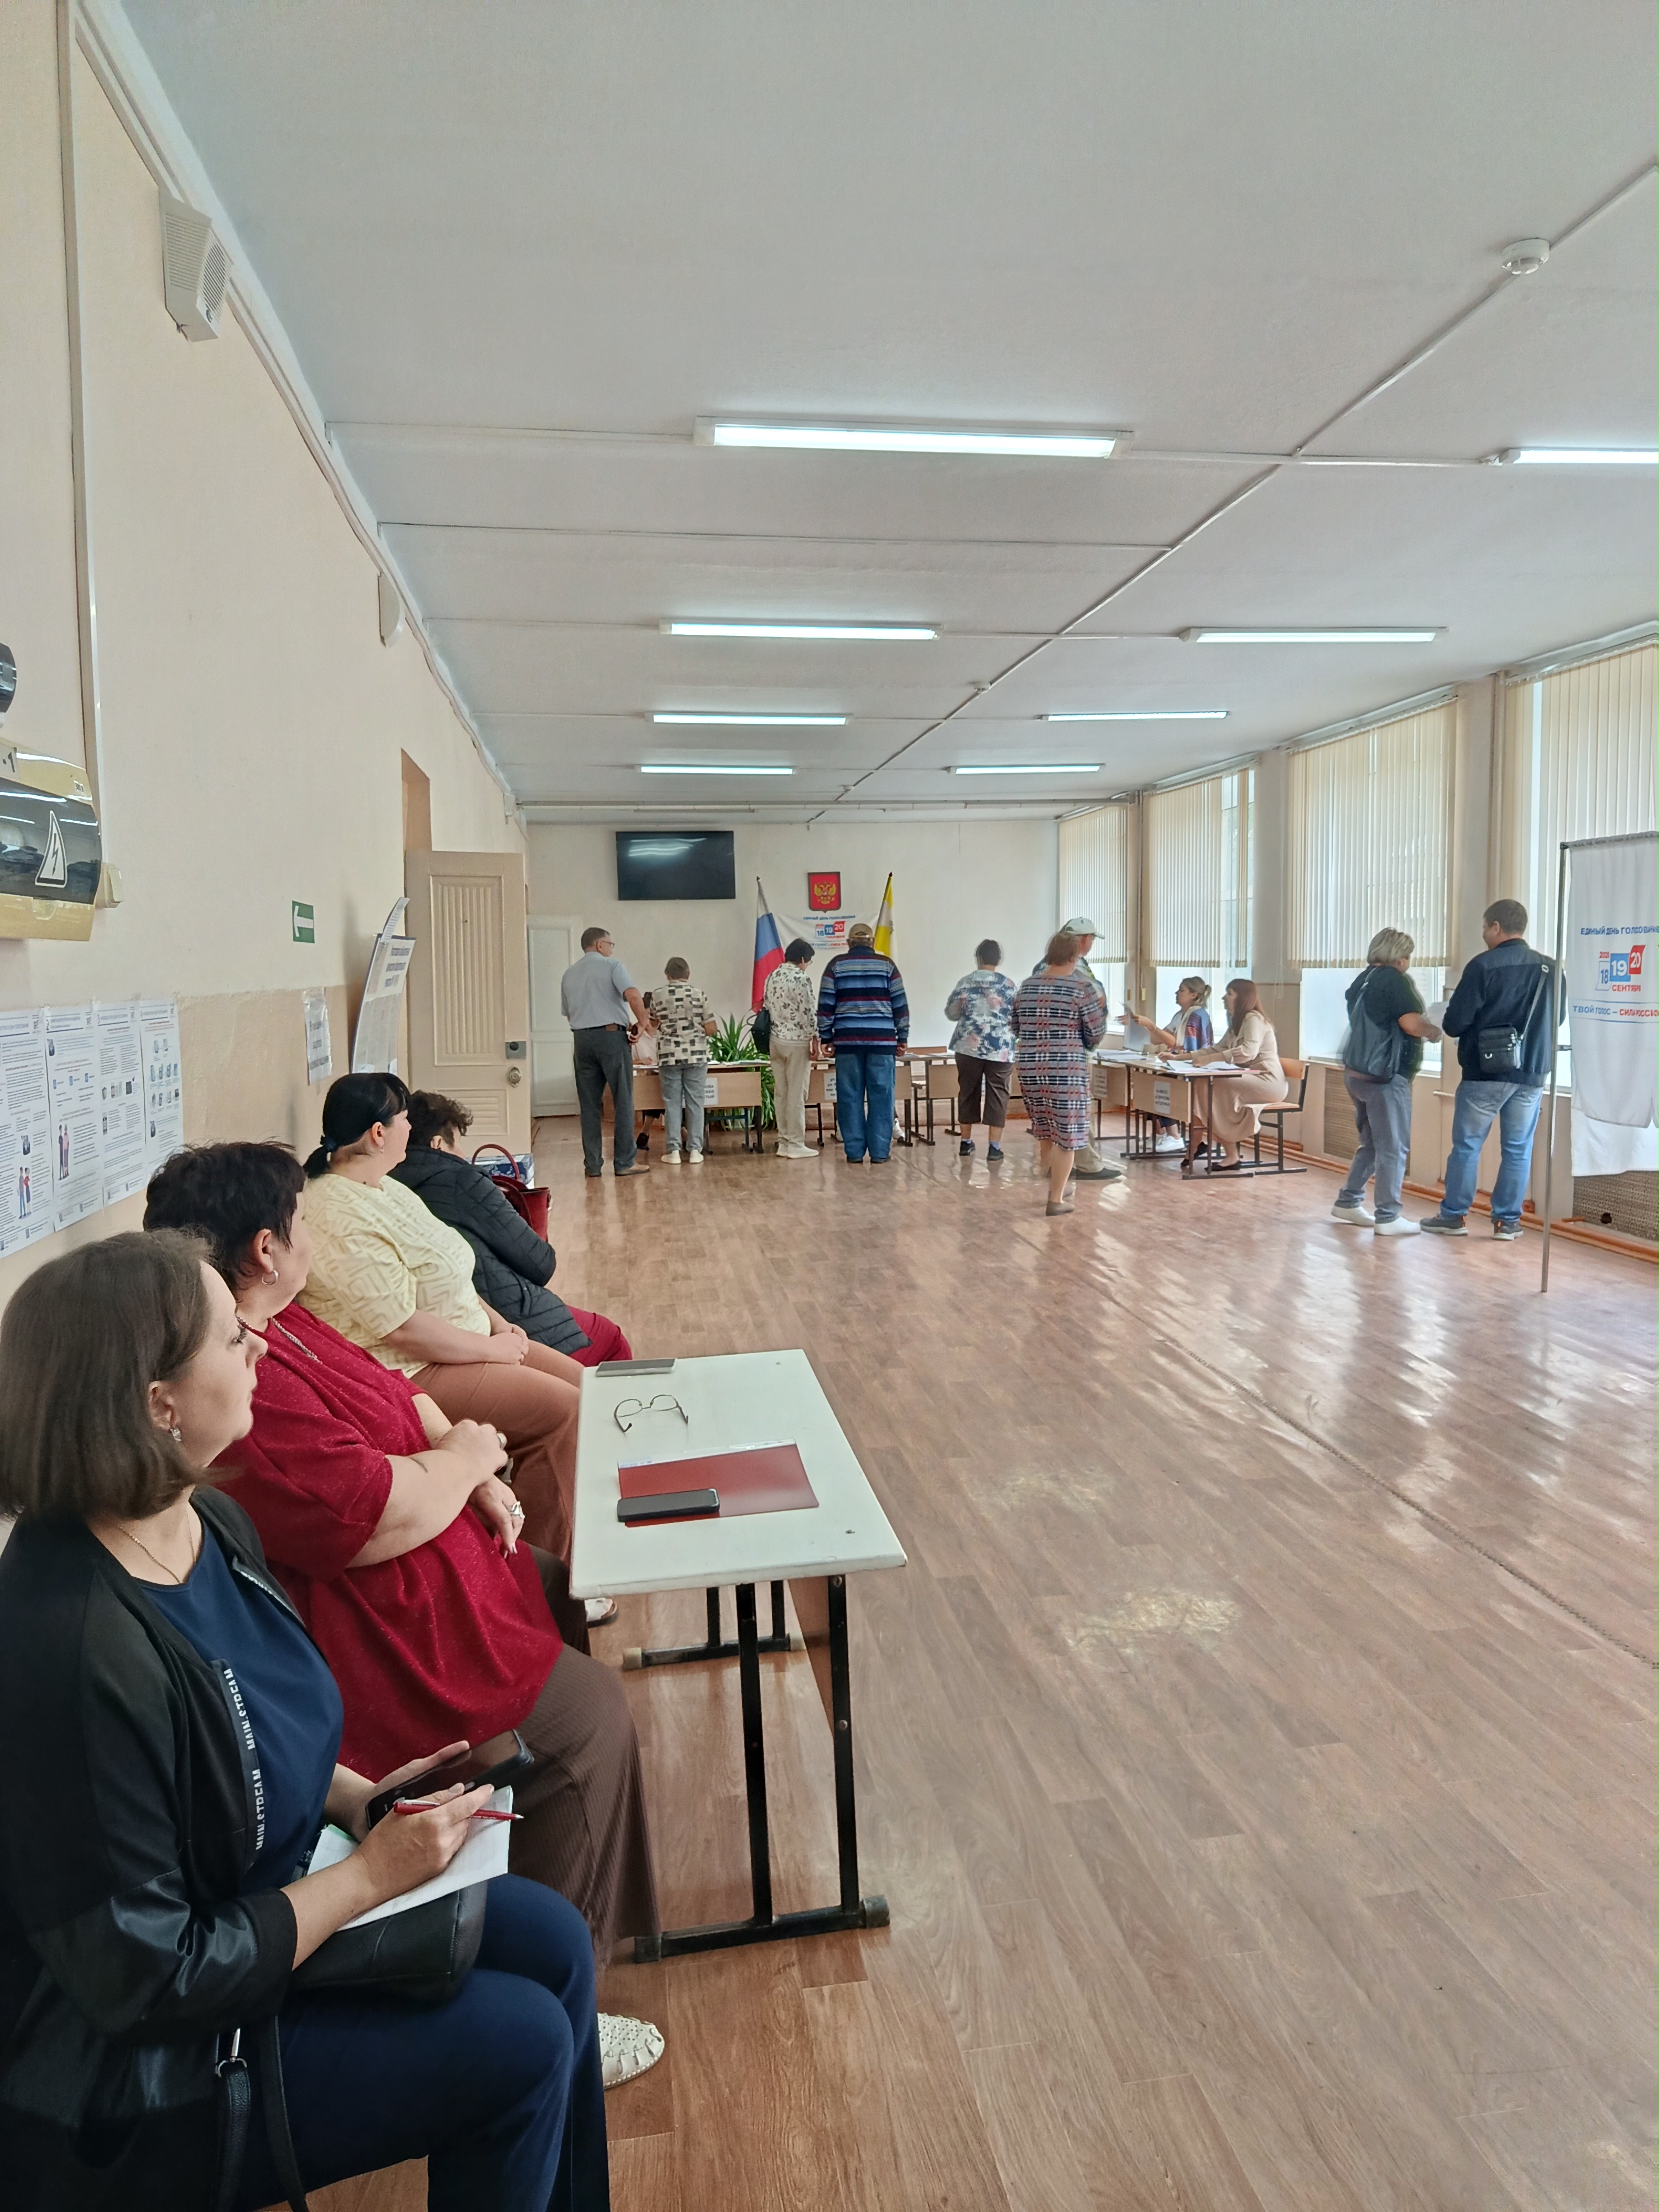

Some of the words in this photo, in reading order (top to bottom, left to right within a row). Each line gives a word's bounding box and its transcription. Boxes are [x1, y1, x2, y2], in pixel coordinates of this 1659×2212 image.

[1580, 926, 1605, 935] ЕДИНЫЙ
[1606, 927, 1620, 935] ДЕНЬ
[1630, 952, 1641, 968] 20
[1611, 960, 1627, 977] 19
[1600, 969, 1609, 984] 18
[1573, 1005, 1594, 1014] ТВОЙ
[1595, 1007, 1611, 1015] ГОЛОС
[1619, 1008, 1635, 1016] СИЛА
